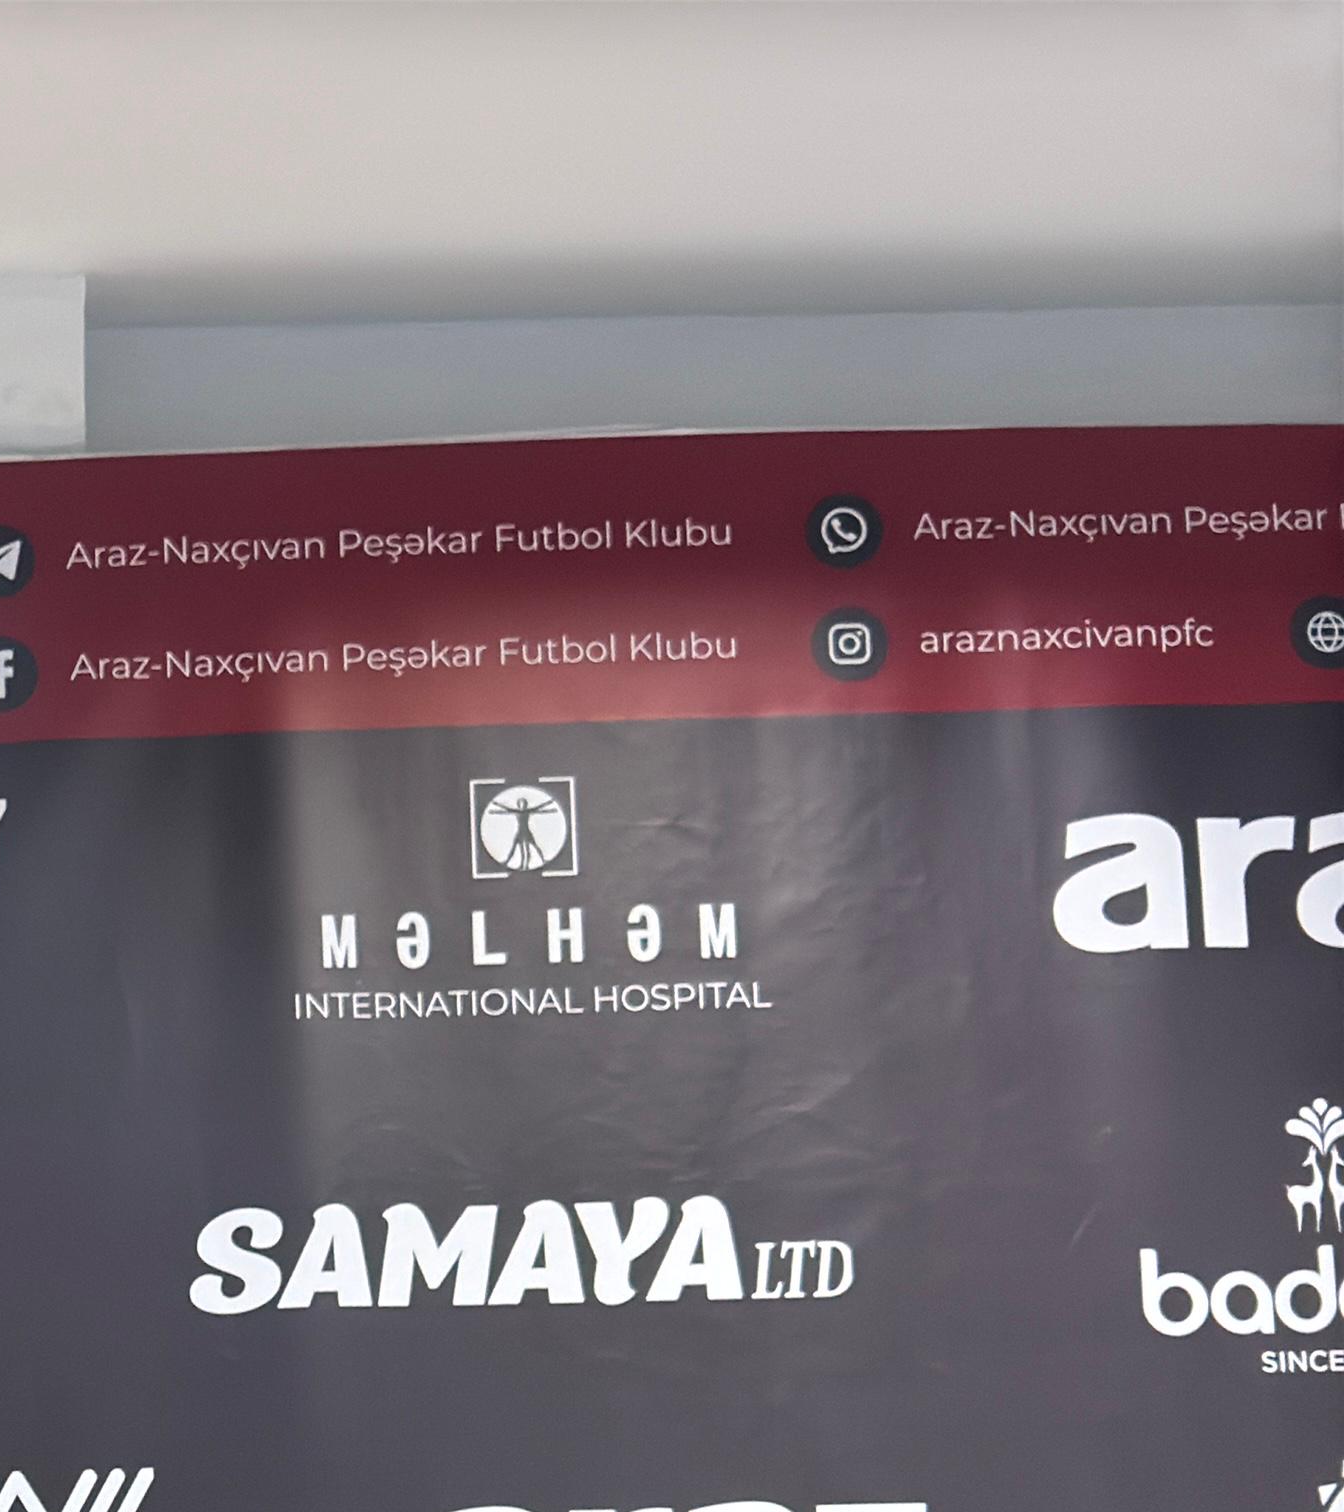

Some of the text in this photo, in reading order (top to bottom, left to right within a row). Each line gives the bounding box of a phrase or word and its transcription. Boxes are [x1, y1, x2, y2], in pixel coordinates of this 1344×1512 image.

[66, 518, 731, 570] Araz-Naxçıvan Peşəkar Futbol Klubu
[913, 510, 1172, 543] Araz-Naxçıvan
[1184, 503, 1328, 540] Peşəkar
[70, 631, 736, 682] Araz-Naxçıvan Peşəkar Futbol Klubu
[920, 617, 1213, 654] araznaxcivanpfc
[294, 981, 773, 1020] INTERNATIONAL HOSPITAL
[189, 1194, 854, 1315] SAMAYA LTD
[1139, 1244, 1344, 1337] bad
[1261, 1349, 1344, 1374] SINCE
